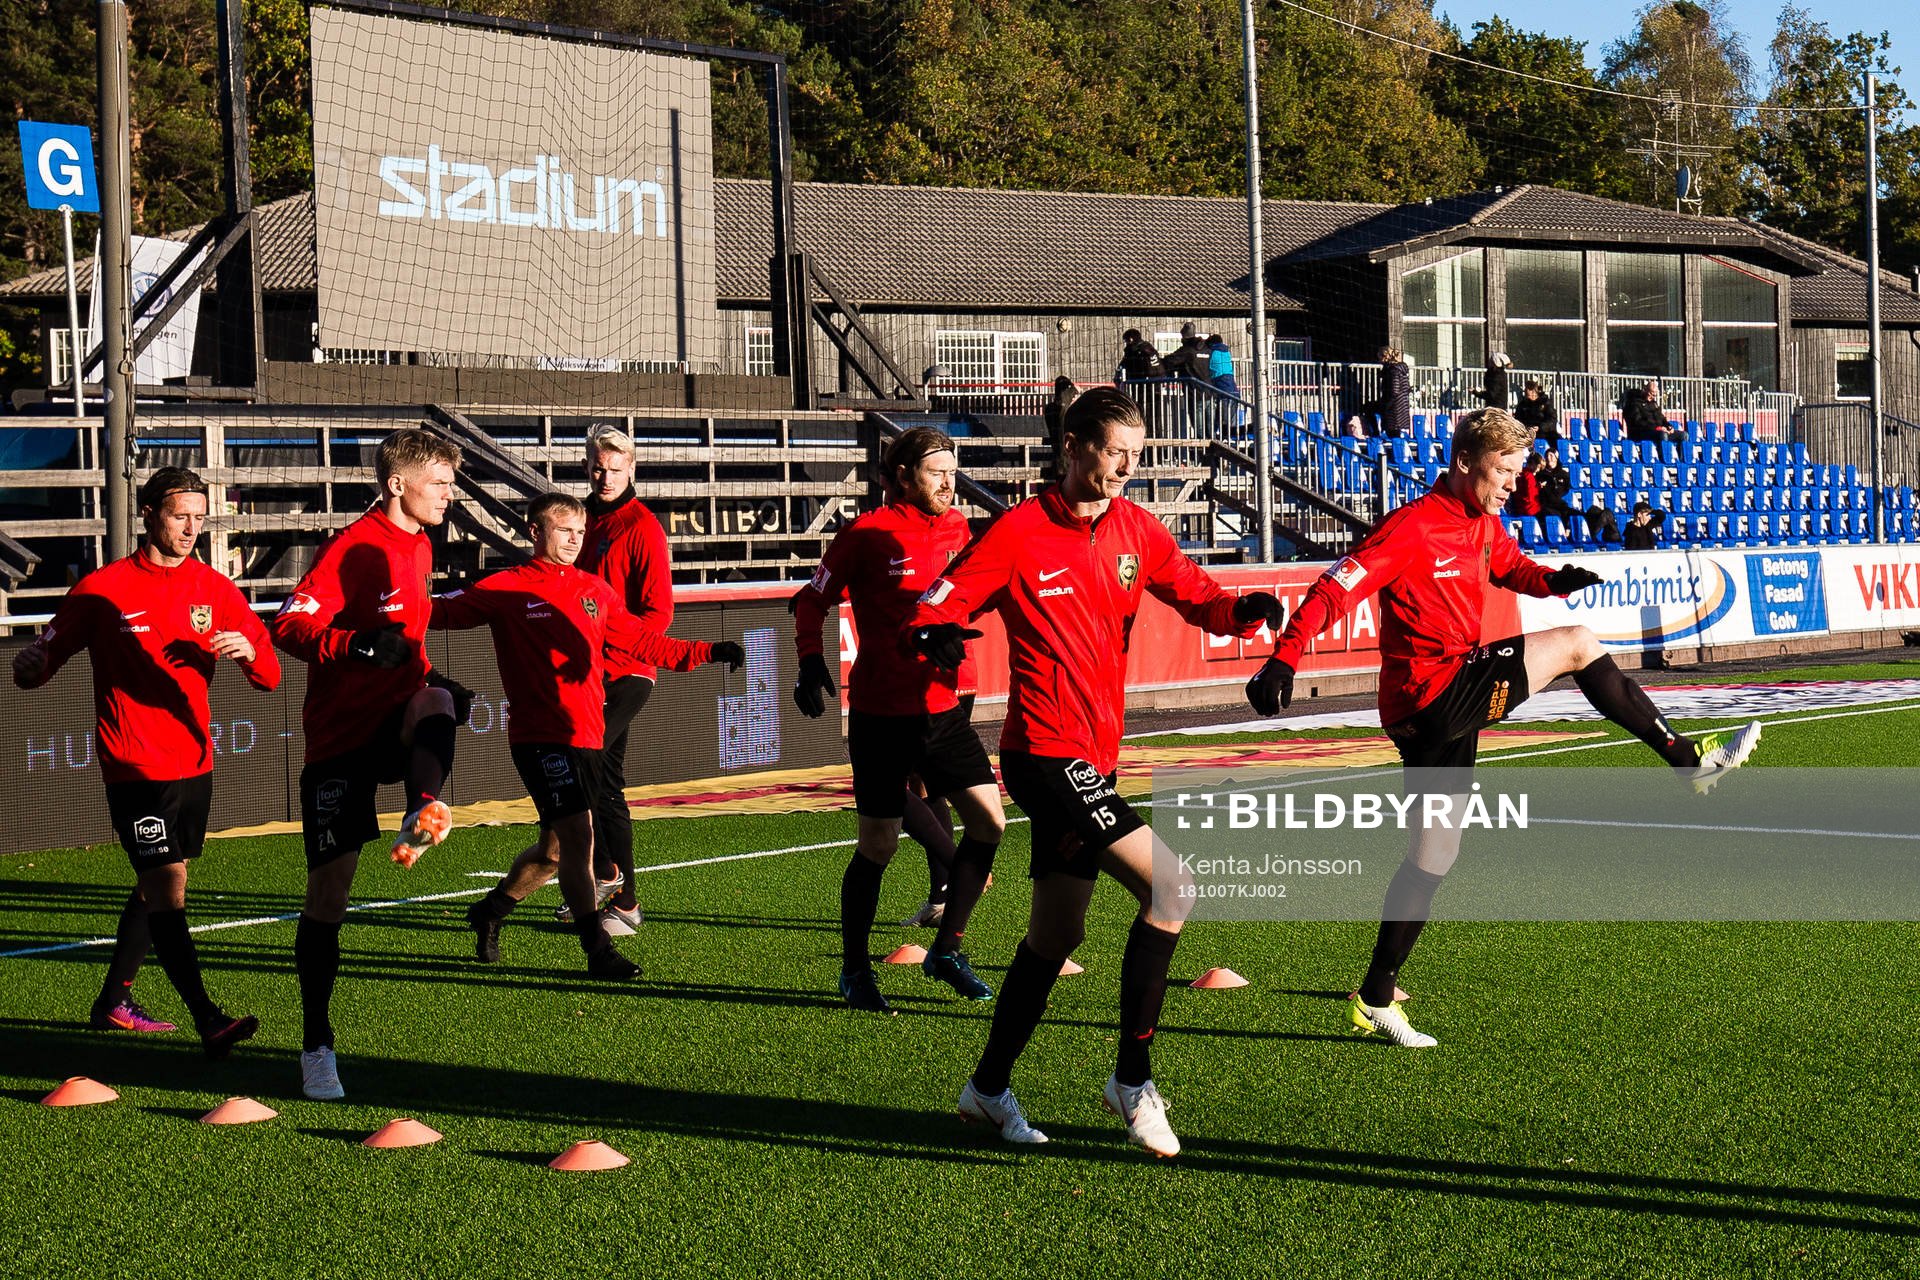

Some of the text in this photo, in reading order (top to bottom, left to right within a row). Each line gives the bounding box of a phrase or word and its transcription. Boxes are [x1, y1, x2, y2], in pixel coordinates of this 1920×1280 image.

[38, 137, 84, 196] G
[378, 143, 668, 238] stadium
[888, 568, 915, 576] stadium
[1762, 557, 1808, 579] Betong
[1038, 586, 1074, 598] stadium
[1565, 565, 1702, 611] ombimix
[1764, 582, 1804, 604] Fasad
[1769, 611, 1798, 631] Golv
[1082, 787, 1116, 805] fodi.se
[1091, 805, 1117, 831] 15
[139, 823, 162, 836] fodi
[139, 845, 169, 857] fodi.se
